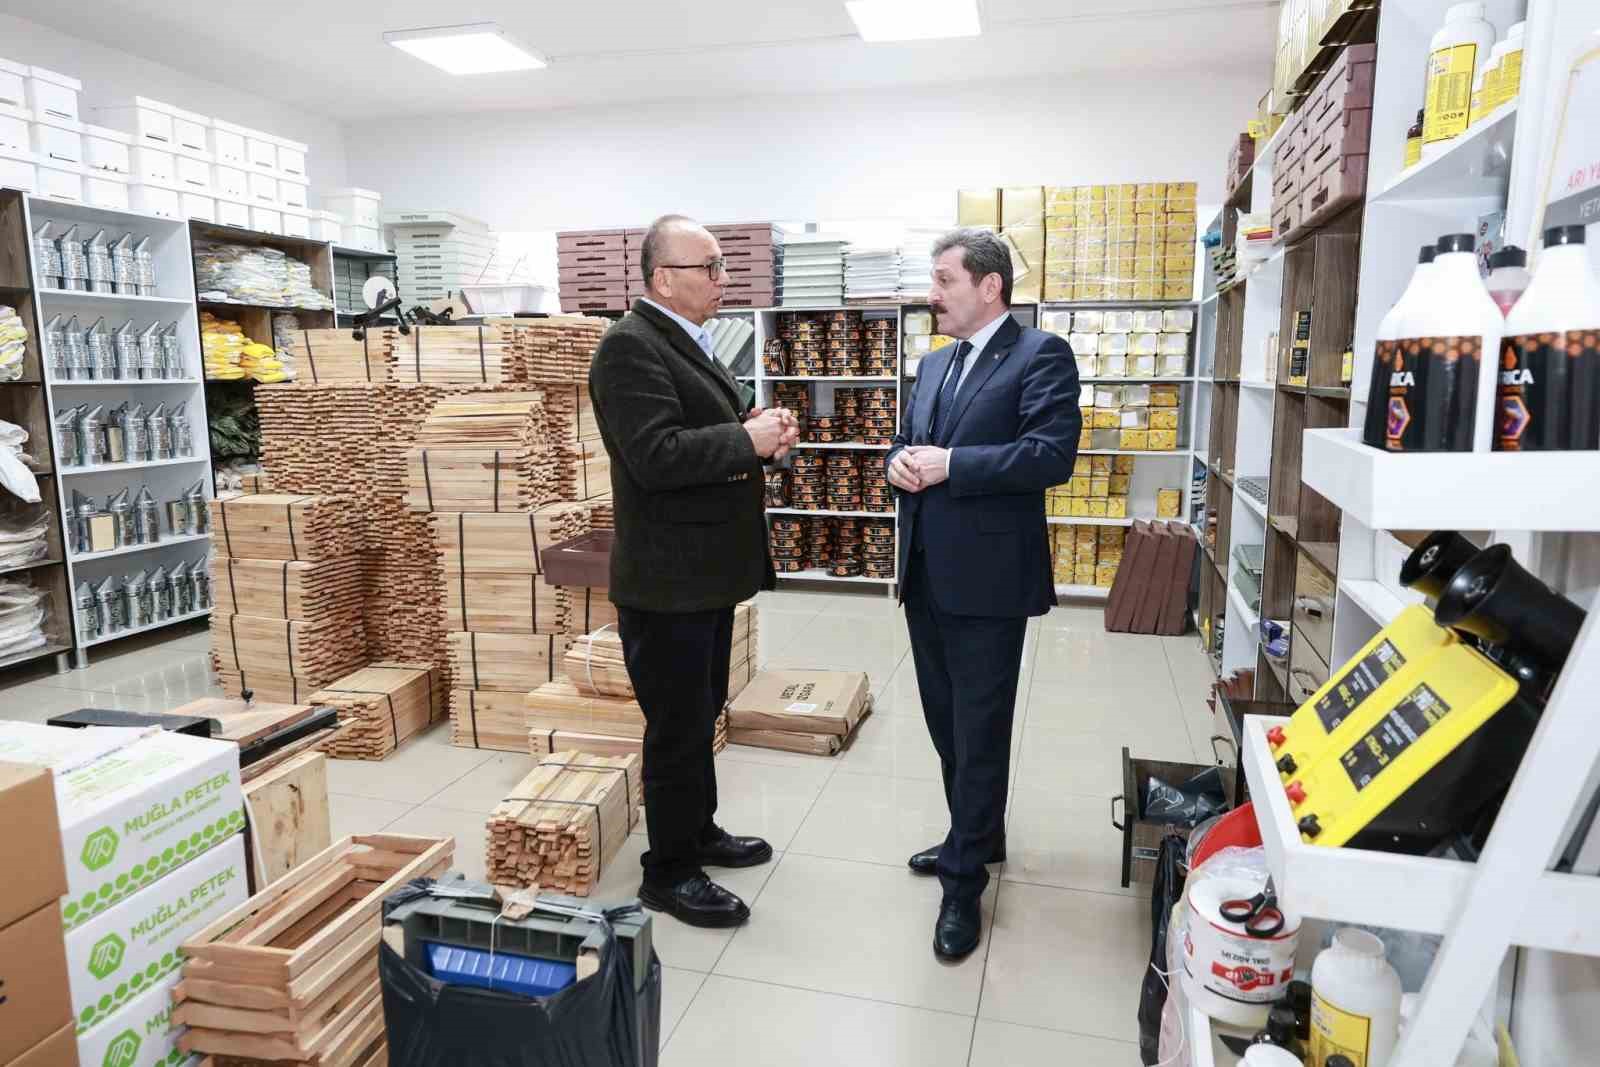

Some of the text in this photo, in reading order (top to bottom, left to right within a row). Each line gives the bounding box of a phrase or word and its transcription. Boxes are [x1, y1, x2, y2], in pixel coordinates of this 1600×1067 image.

[124, 796, 182, 835] MUĞLA
[185, 769, 231, 804] PETEK
[131, 897, 187, 940] MUĞLA
[190, 865, 235, 902] PETEK
